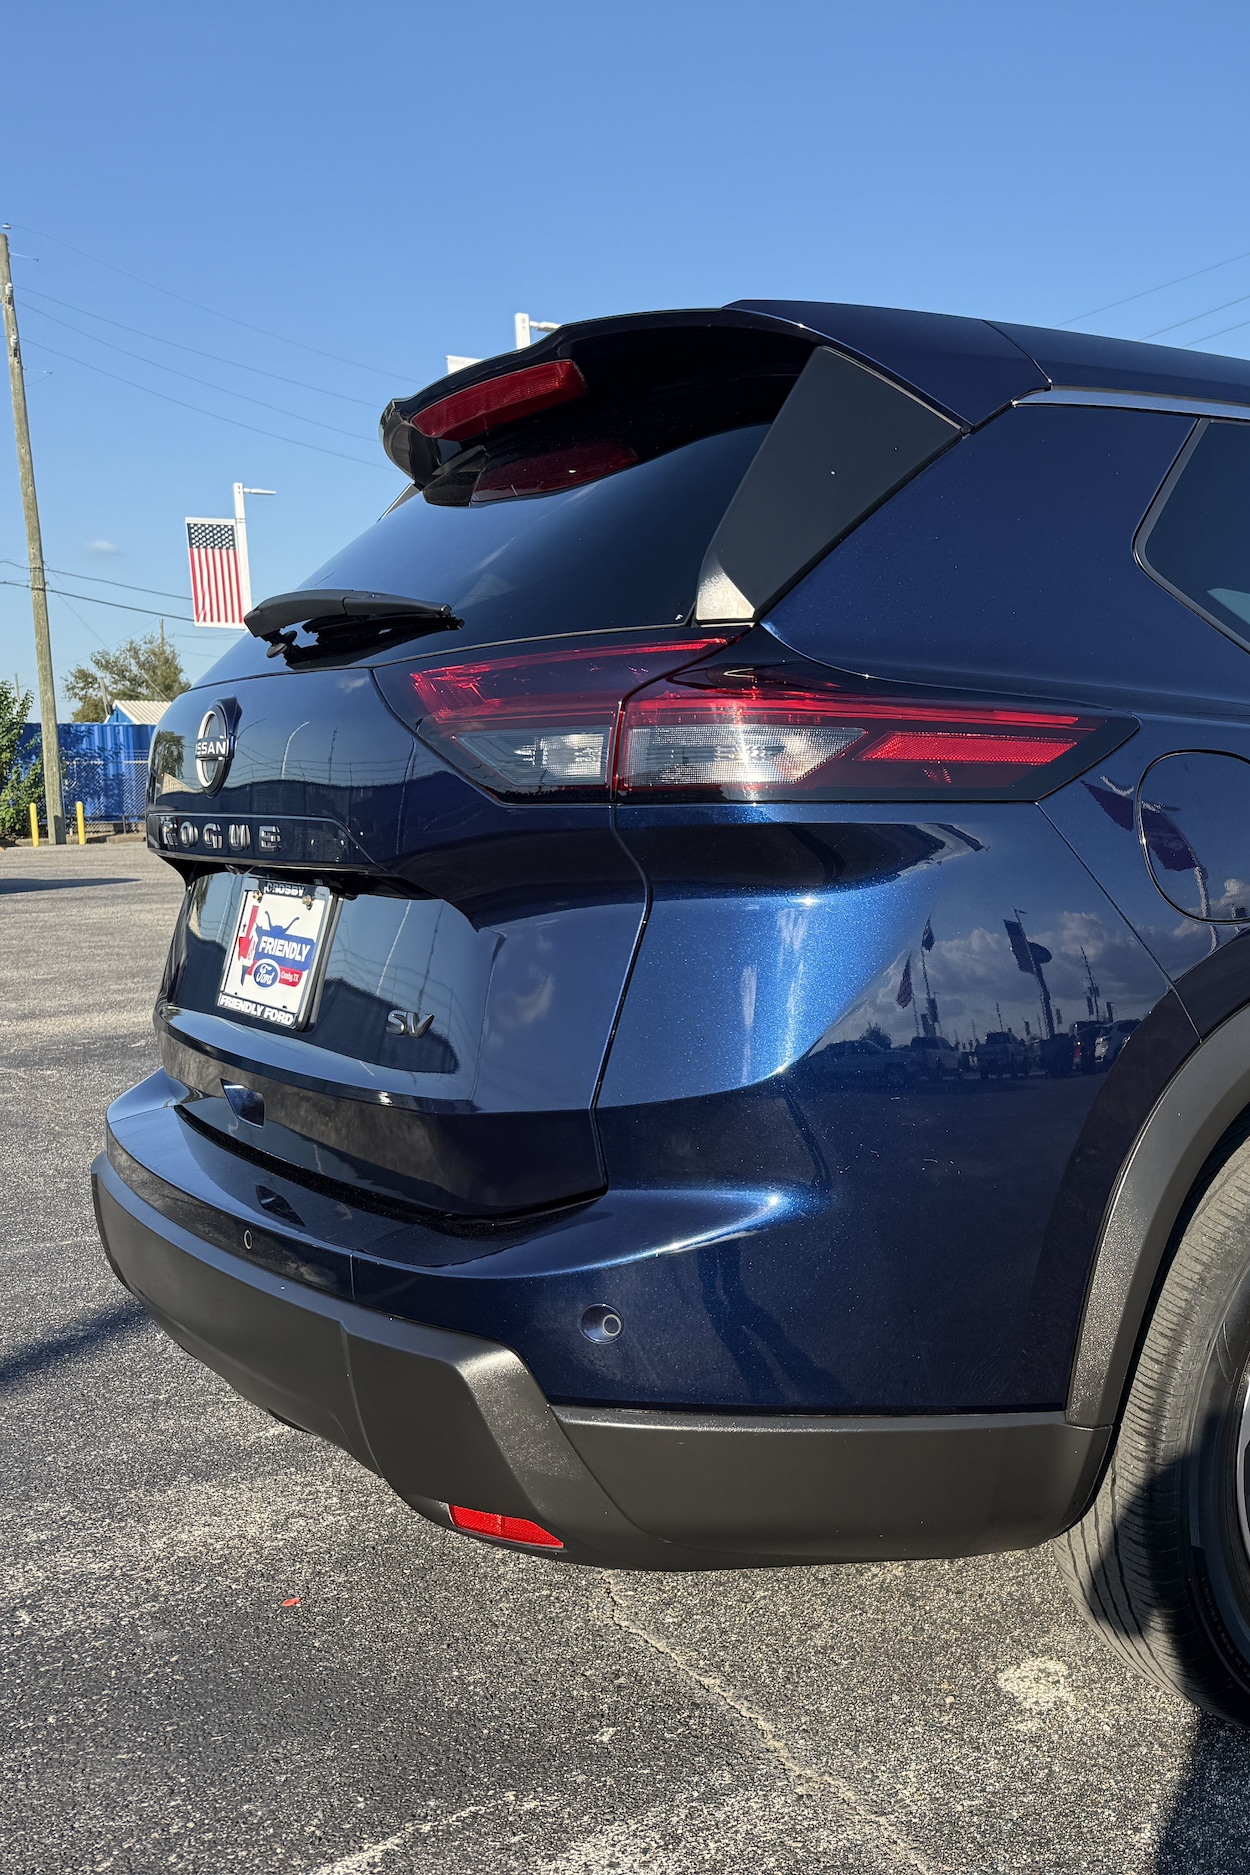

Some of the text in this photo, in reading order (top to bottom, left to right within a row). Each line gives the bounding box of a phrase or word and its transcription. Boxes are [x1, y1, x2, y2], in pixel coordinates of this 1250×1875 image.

[160, 820, 281, 852] ROGUE
[264, 881, 305, 897] CROSBY
[258, 936, 310, 962] FRIENDLY
[255, 964, 275, 985] Ford
[219, 995, 294, 1026] FRIENDLY FORD
[386, 1009, 435, 1038] SV
